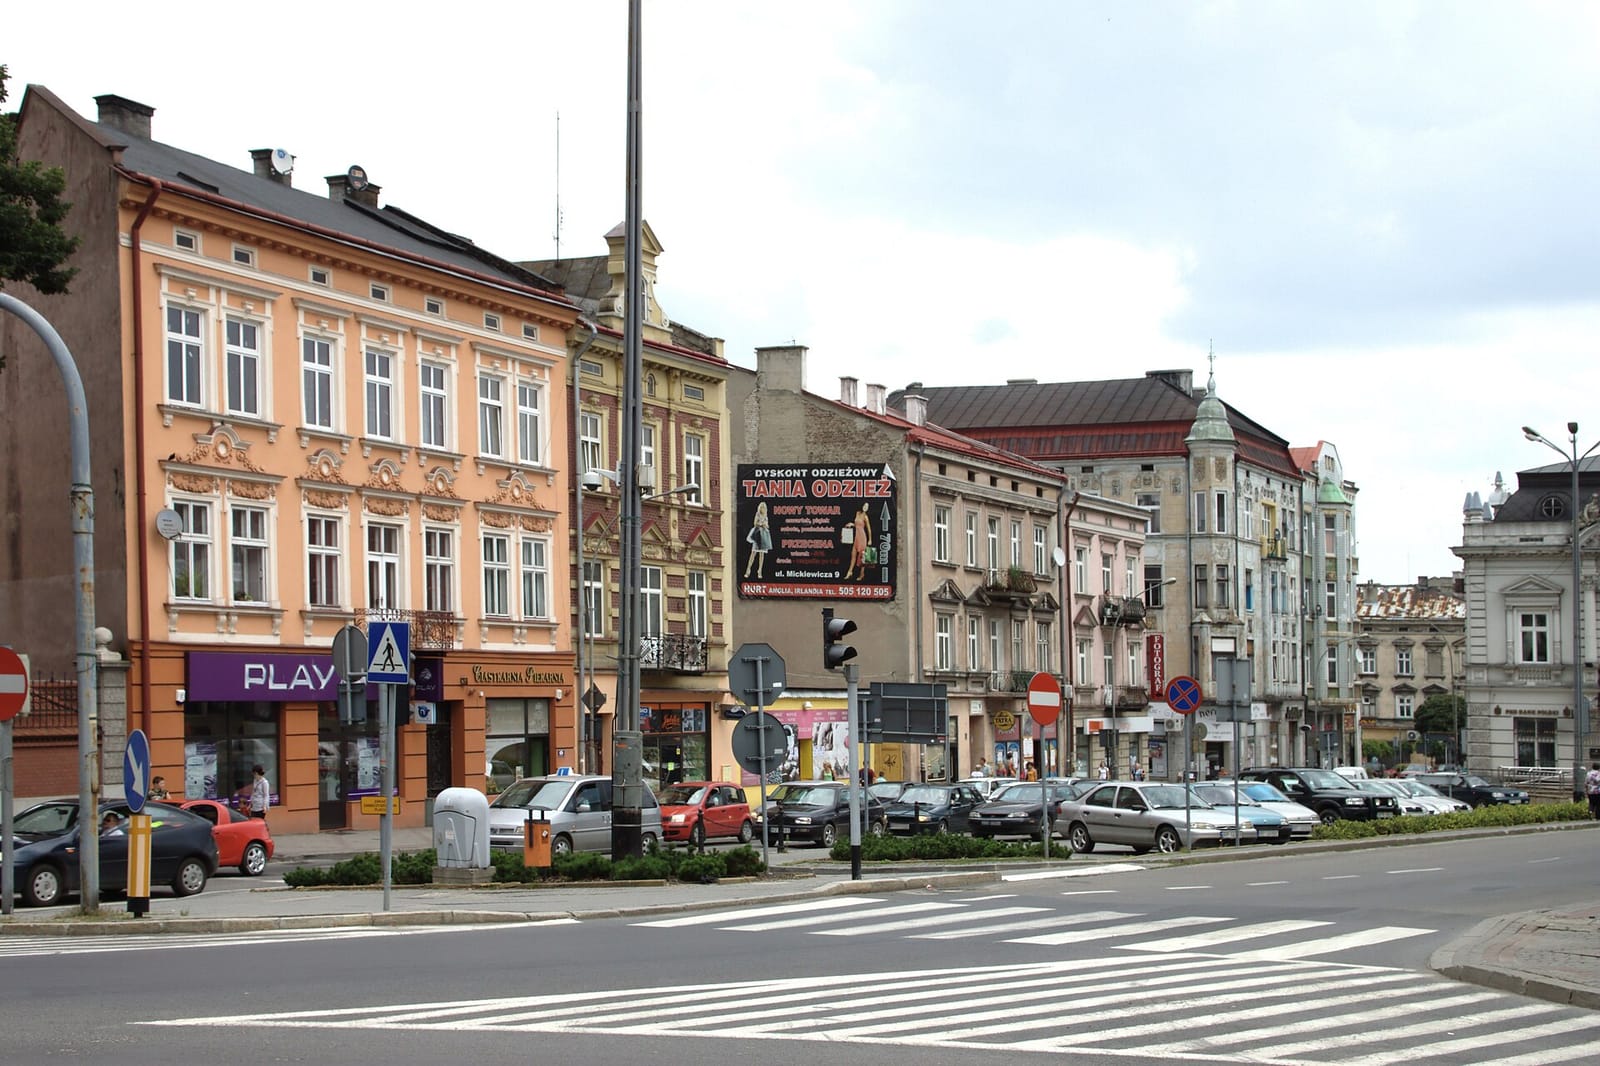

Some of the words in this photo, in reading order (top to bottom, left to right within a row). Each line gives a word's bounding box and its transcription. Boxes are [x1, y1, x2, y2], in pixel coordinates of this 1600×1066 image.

[755, 468, 808, 478] DYSKONT
[811, 466, 878, 477] ODZIEŻOWY
[743, 479, 807, 498] TANIA
[811, 475, 892, 498] ODZIEŻ
[773, 505, 803, 515] NOWY
[804, 505, 841, 515] TOWAR
[775, 570, 785, 578] ul.
[786, 570, 833, 578] Mickiewicza
[834, 570, 841, 578] 9
[743, 584, 767, 594] HURT
[838, 586, 854, 595] 505
[856, 587, 871, 596] 120
[873, 587, 889, 596] 505
[1153, 635, 1162, 692] FOTOGRAF
[244, 663, 335, 690] PLAY
